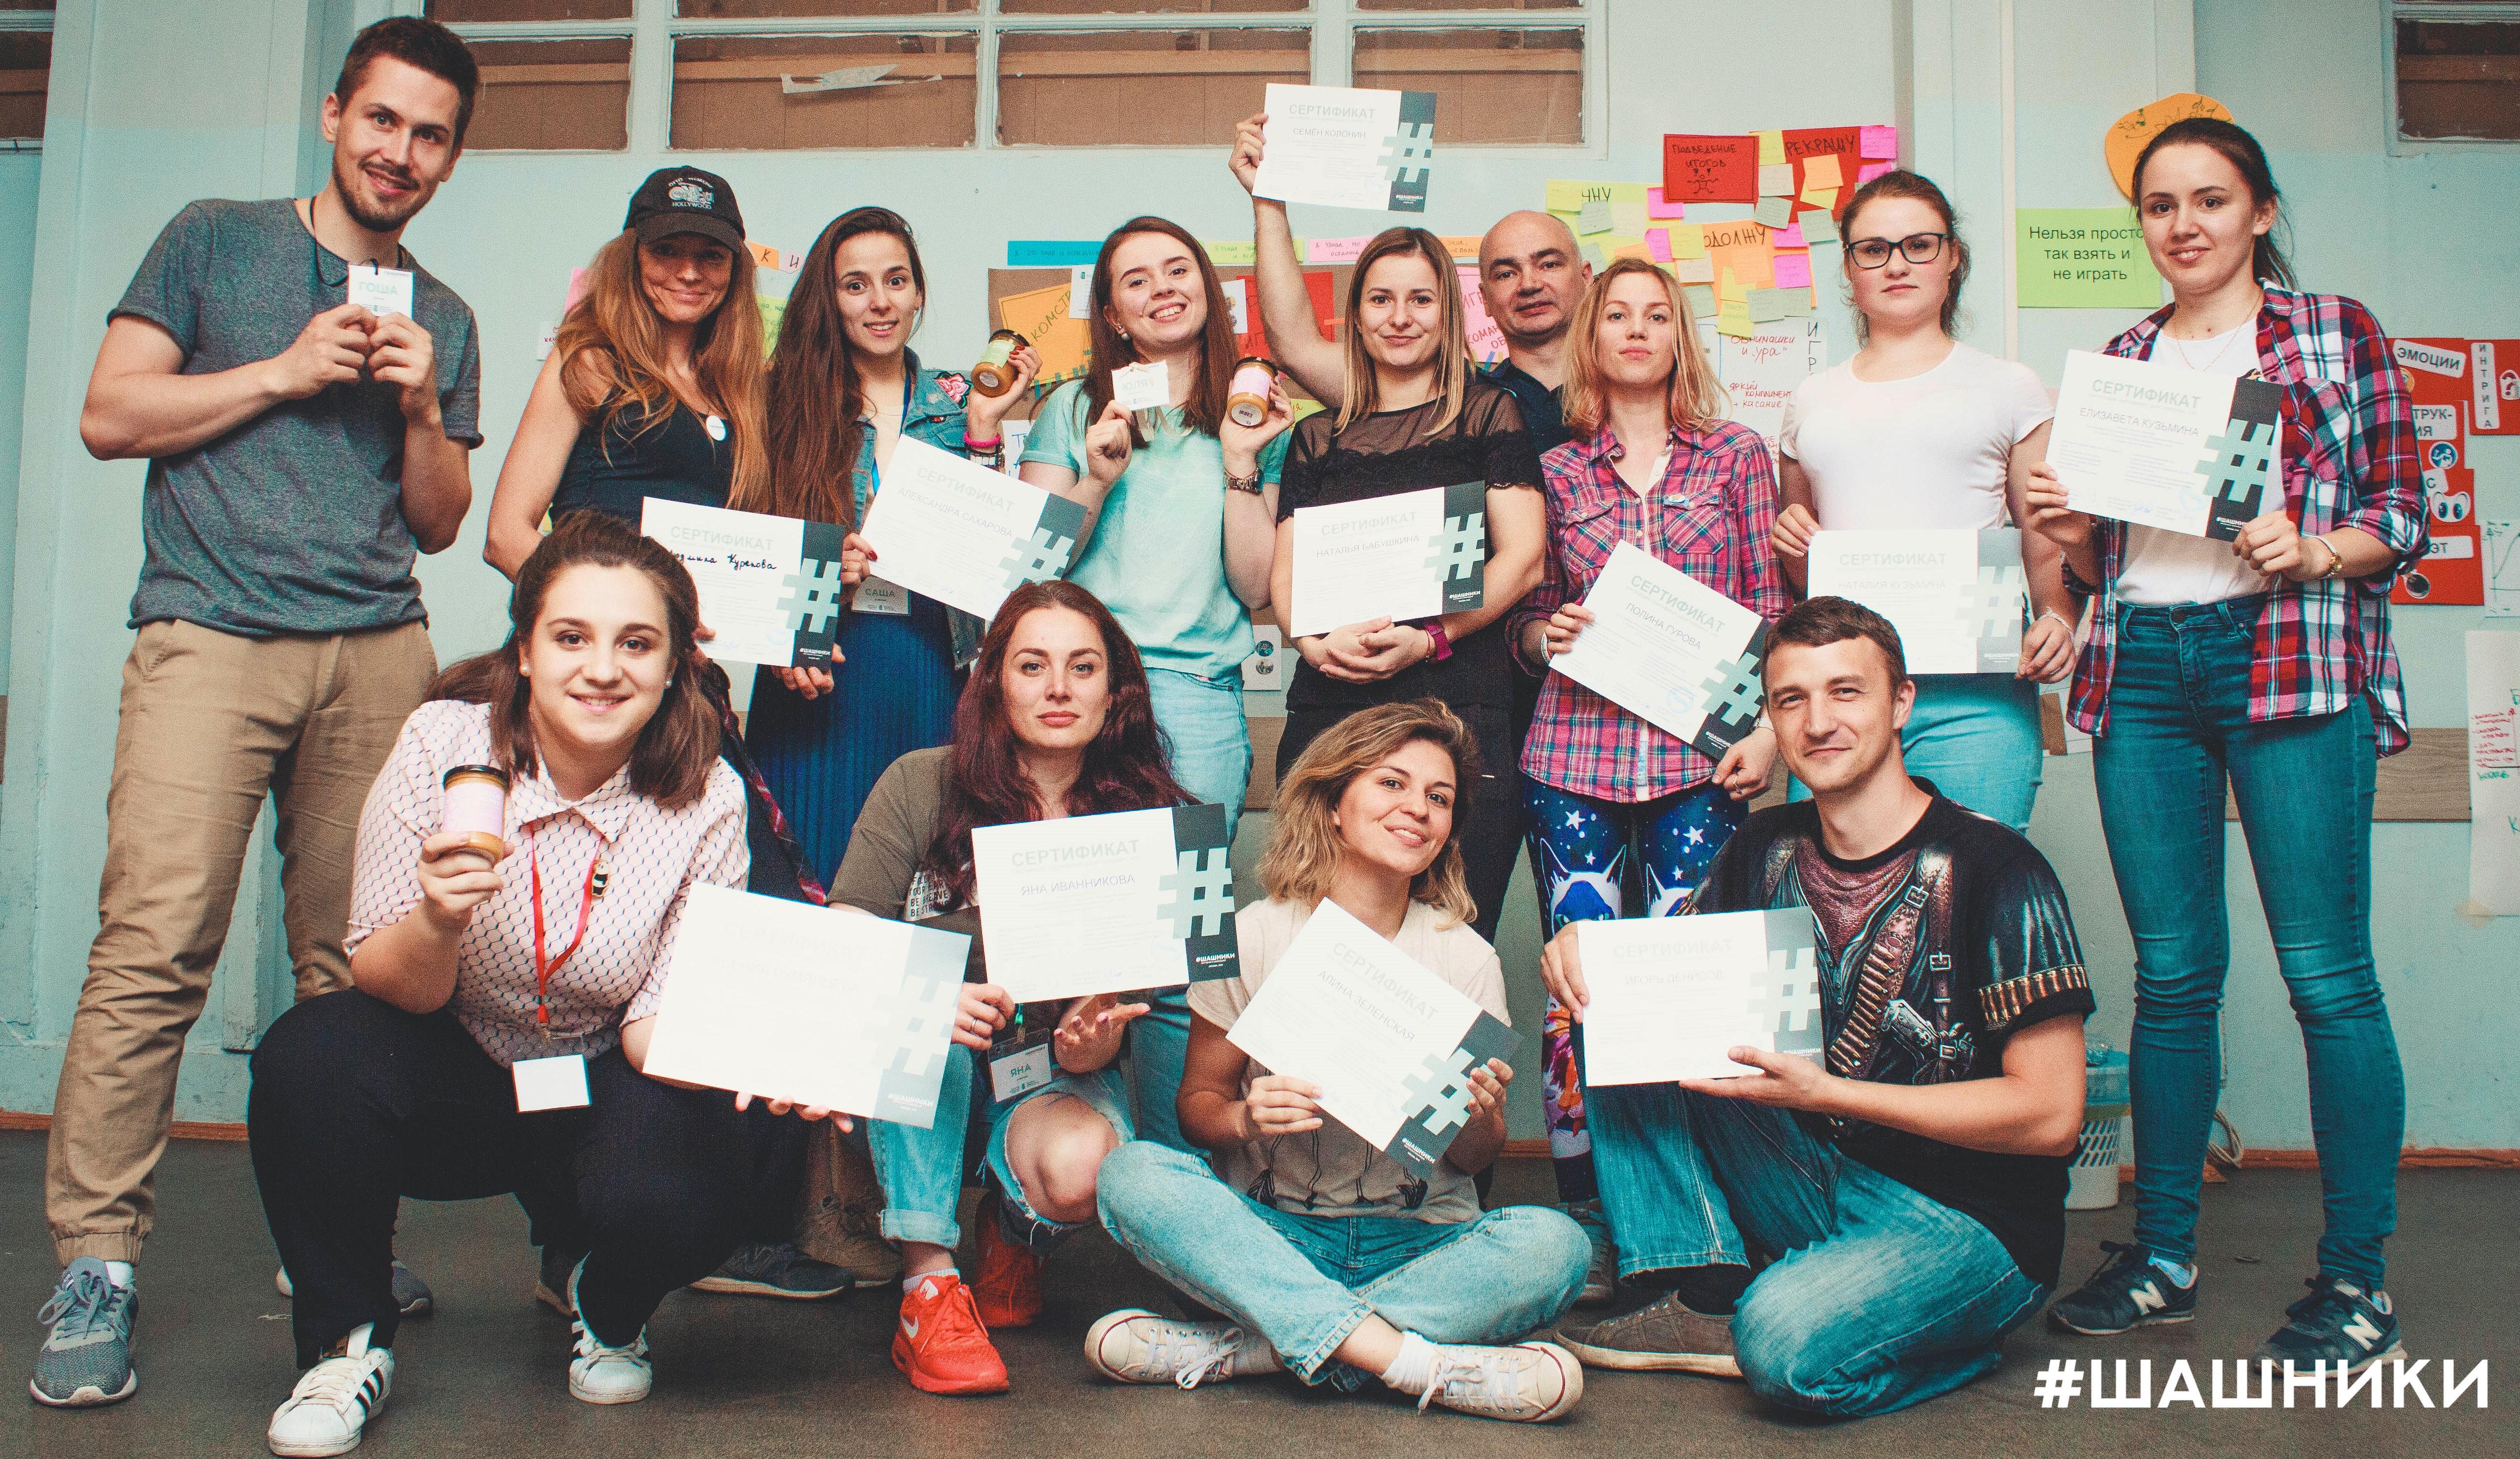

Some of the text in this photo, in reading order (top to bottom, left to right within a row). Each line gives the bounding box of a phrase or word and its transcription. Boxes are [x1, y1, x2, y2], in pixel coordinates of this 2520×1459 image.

[1289, 104, 1376, 119] СЕРТИФИКАТ
[1293, 128, 1366, 139] СЕМЁН КОЛОНИН
[672, 201, 713, 210] HOLLYWOOD
[1704, 227, 1767, 248] ОДОЛЖУ
[2030, 227, 2144, 243] Нельзя просто
[2045, 249, 2130, 260] так взять и
[2053, 269, 2127, 283] не играть
[358, 281, 399, 296] ГОША
[2397, 347, 2461, 371] ЭМОЦИИ
[1122, 379, 1148, 391] ЮЛЯ
[2092, 379, 2201, 409] СЕРТИФИКАТ
[2478, 343, 2493, 428] ИНТРИГА
[2079, 407, 2199, 437] ЕЛИЗАВЕТА КУЗЬМИНА
[2412, 408, 2453, 420] ТРУК-
[917, 466, 1015, 512] СЕРТИФИКАТ
[897, 487, 1013, 537] АЛЕКСАНДРА САХАРОВА
[1321, 511, 1417, 536] СЕРТИФИКАТ
[670, 526, 774, 551] СЕРТИФИКАТ
[1316, 535, 1420, 558] НАТАЛЬЯ БАБУШКИНА
[1839, 553, 1947, 565] СЕРТИФИКАТ
[865, 588, 895, 596] САША
[1449, 590, 1481, 599] #ШАШНИКИ
[1839, 580, 1946, 589] НАТАЛИЯ КУЗЬМИНА
[1631, 575, 1726, 632] СЕРТИФИКАТ
[1626, 603, 1702, 650] ПОЛИНА ГУРОВА
[1011, 839, 1139, 867] СЕРТИФИКАТ
[1021, 874, 1136, 896] ЯНА ИВАННИКОВА
[1195, 952, 1235, 963] #ШАШНИКИ
[1613, 938, 1733, 959] СЕРТИФИКАТ
[1333, 942, 1439, 1021] СЕРТИФИКАТ
[1625, 970, 1724, 986] ИГОРЬ ДЕНИСОВ
[1317, 970, 1415, 1043] АЛИНА ЗЕЛЕНСКАЯ
[1010, 1064, 1032, 1077] ЯНА
